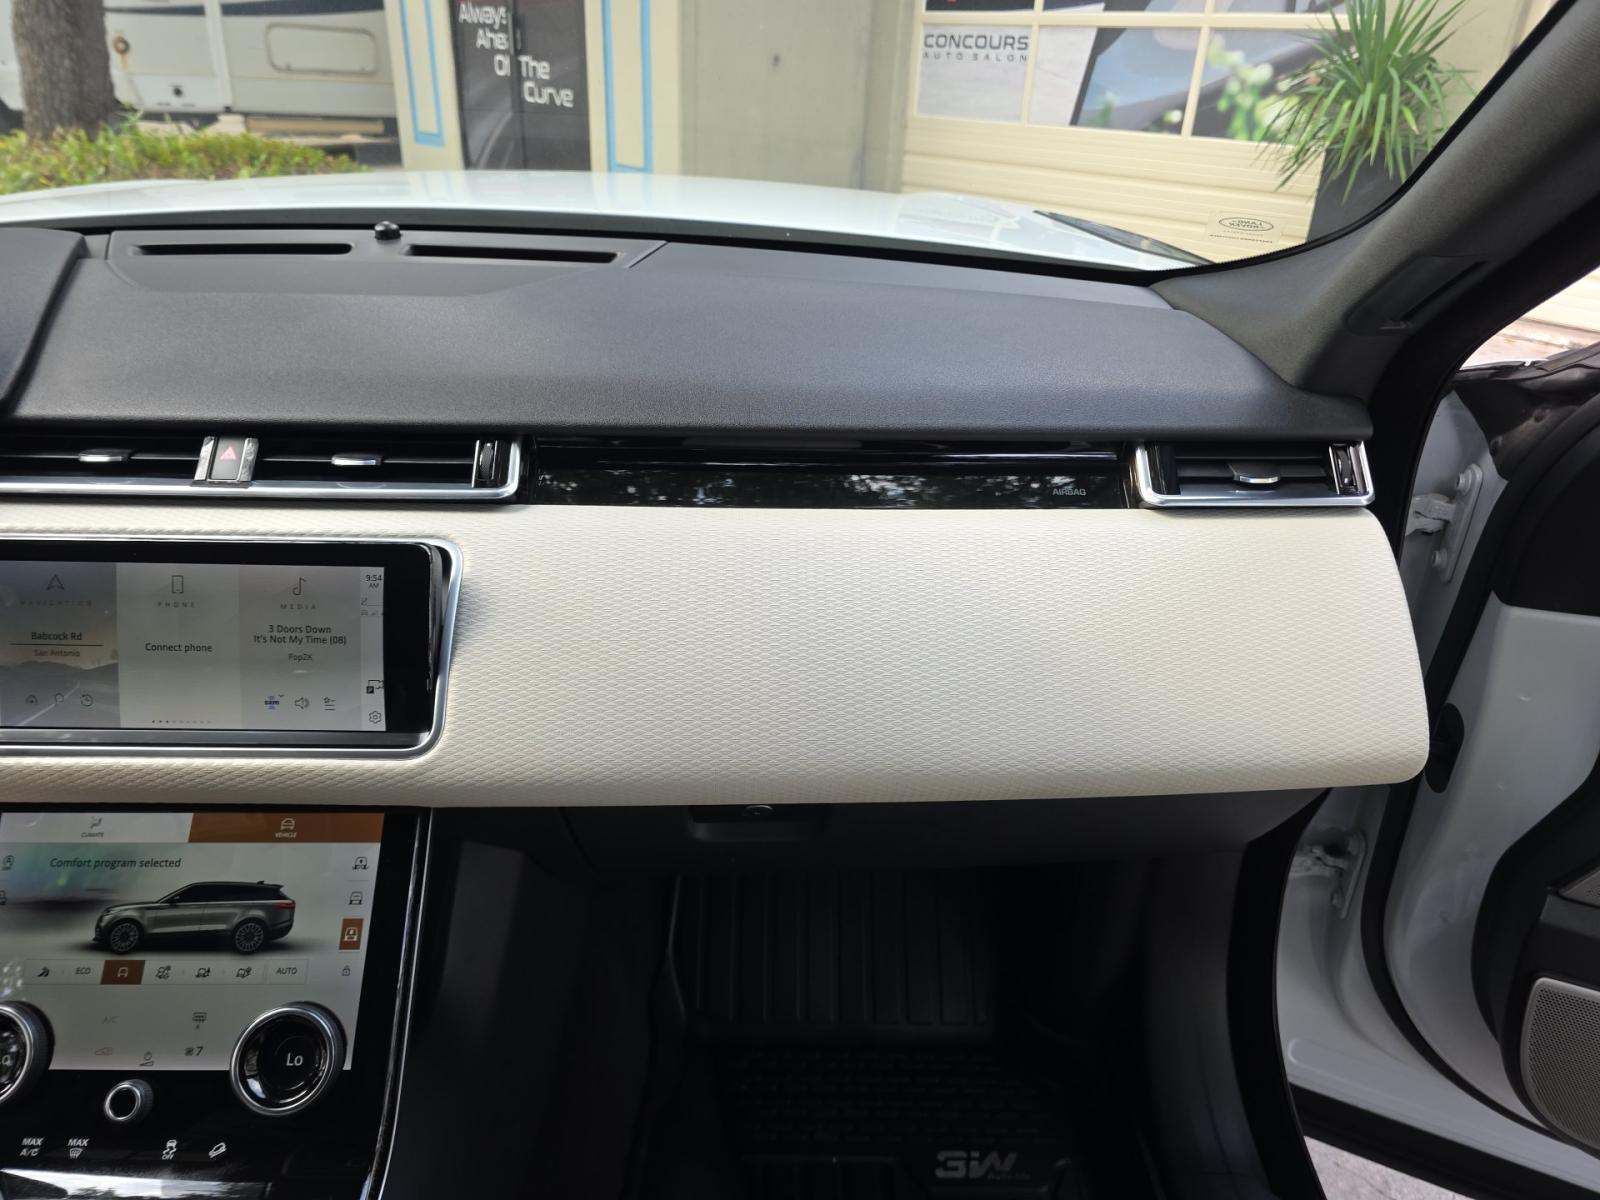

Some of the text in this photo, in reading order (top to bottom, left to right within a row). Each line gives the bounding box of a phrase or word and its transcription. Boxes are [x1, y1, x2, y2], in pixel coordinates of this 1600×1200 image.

[924, 34, 1029, 50] CONCOURS
[923, 52, 1027, 62] AUTO SALON
[518, 55, 551, 79] The
[523, 81, 574, 107] Curve
[1052, 488, 1087, 496] AIRBAG
[365, 574, 382, 582] 9:54
[268, 625, 331, 633] 3 Doors Down
[31, 632, 82, 640] Babcock Rd
[254, 635, 346, 645] It's Not My Time (08)
[145, 642, 213, 653] Connect phone
[50, 858, 182, 870] Comfort program selected
[75, 967, 91, 975] ECO
[276, 967, 298, 975] AUTO
[286, 1052, 303, 1066] Lo
[22, 1137, 43, 1146] MAX
[67, 1138, 89, 1147] MAX
[20, 1148, 39, 1157] A/C
